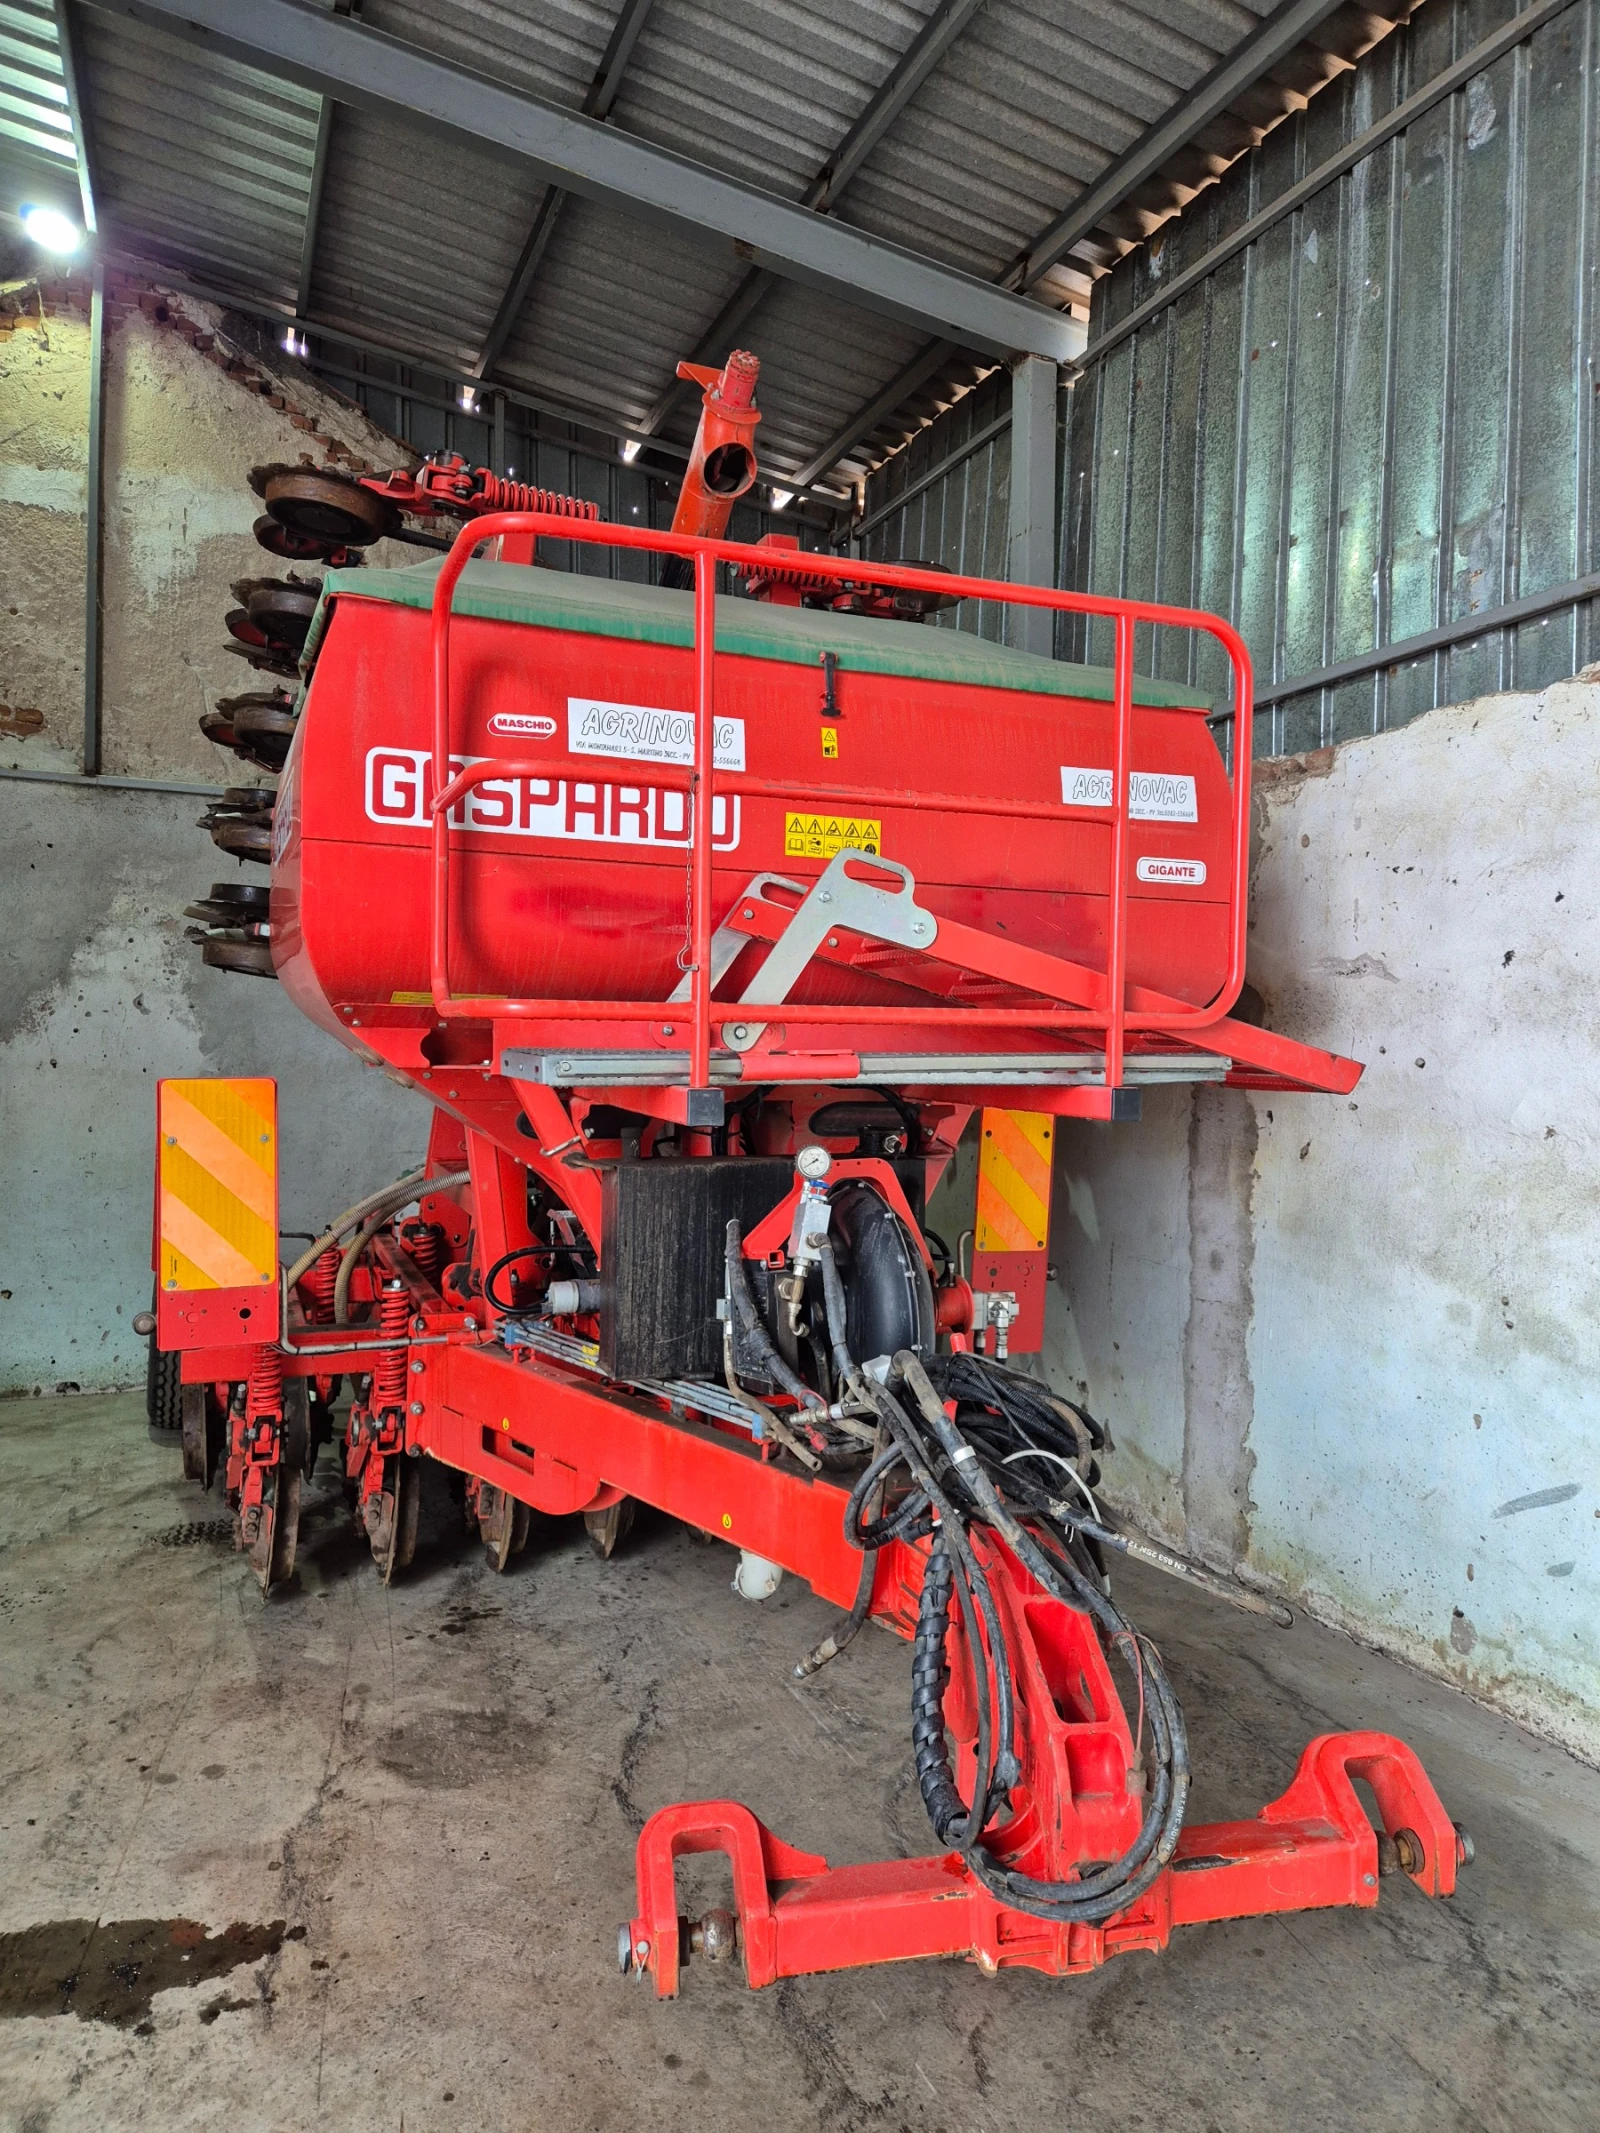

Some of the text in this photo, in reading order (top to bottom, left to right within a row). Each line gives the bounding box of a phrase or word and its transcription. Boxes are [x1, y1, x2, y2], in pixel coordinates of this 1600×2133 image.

[497, 718, 553, 731] MASCHIO
[1072, 774, 1188, 805] AGRNOVAC
[1148, 864, 1196, 878] GIGANTE
